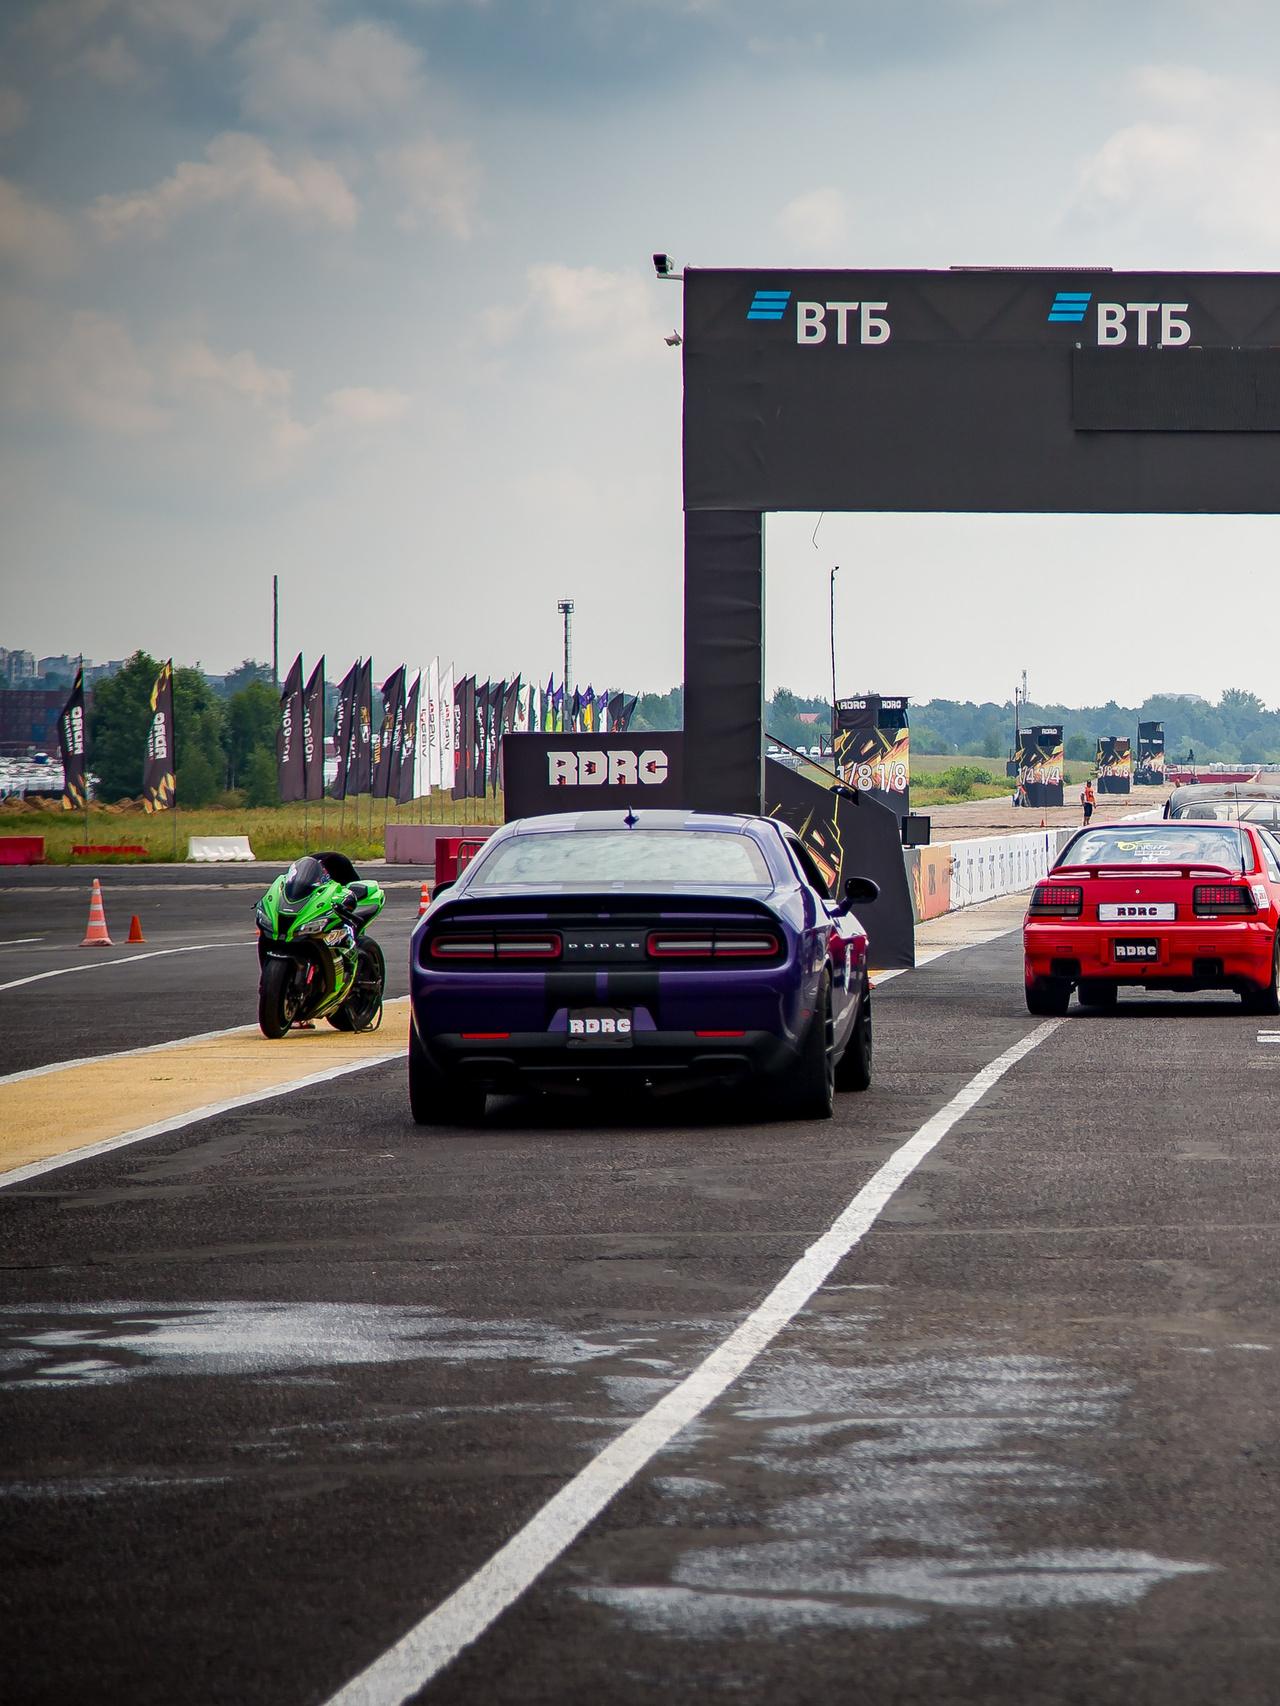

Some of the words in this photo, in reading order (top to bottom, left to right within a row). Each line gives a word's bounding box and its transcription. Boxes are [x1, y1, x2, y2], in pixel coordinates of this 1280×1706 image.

[796, 301, 892, 345] ВТБ
[1096, 302, 1192, 346] ВТБ
[547, 749, 669, 786] RDRC
[837, 763, 873, 791] 1/8
[878, 761, 907, 793] 1/8
[1040, 767, 1061, 785] 1/4
[1117, 907, 1158, 917] RDRC
[1116, 945, 1157, 956] RDRC
[569, 1018, 631, 1034] RDRC
